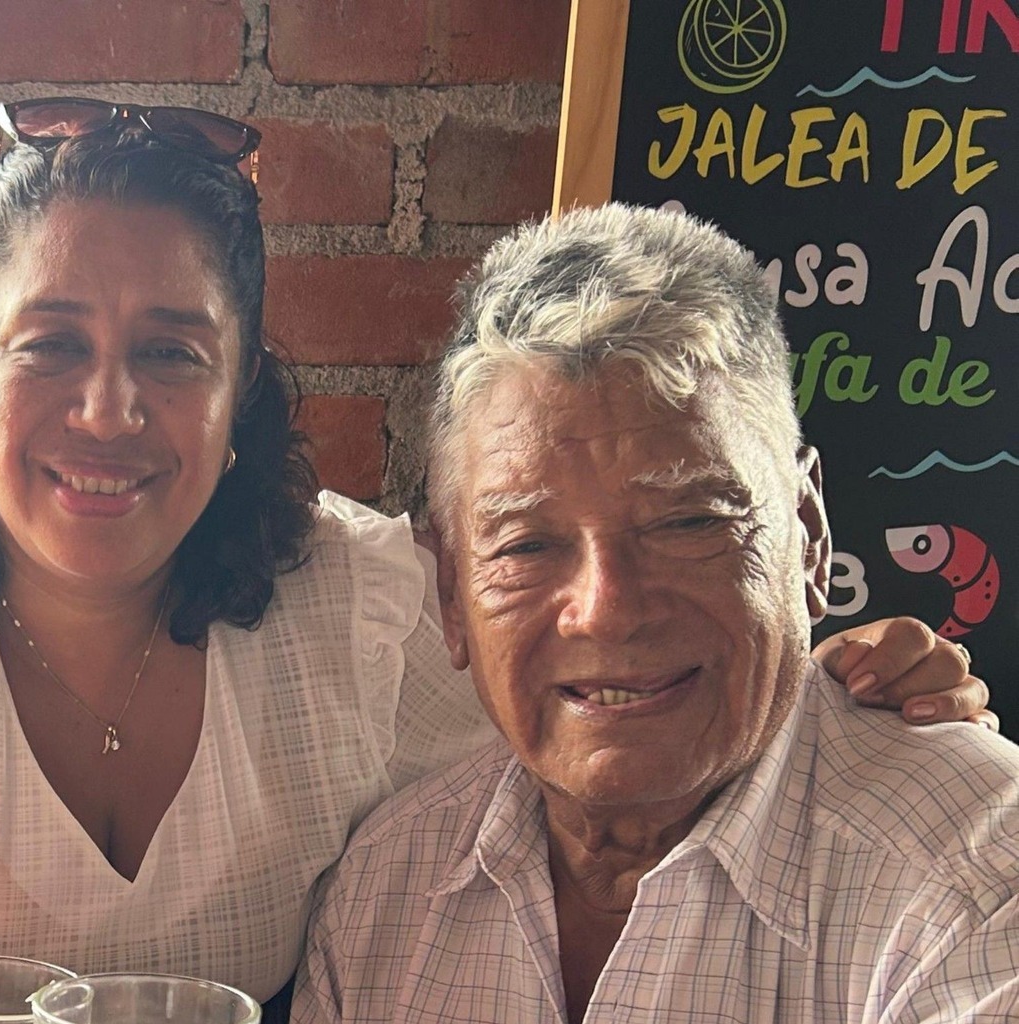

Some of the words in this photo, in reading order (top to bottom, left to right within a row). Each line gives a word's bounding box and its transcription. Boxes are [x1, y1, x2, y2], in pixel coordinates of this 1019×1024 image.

[647, 103, 871, 188] JALEA
[895, 107, 1008, 194] DE
[899, 336, 996, 407] de
